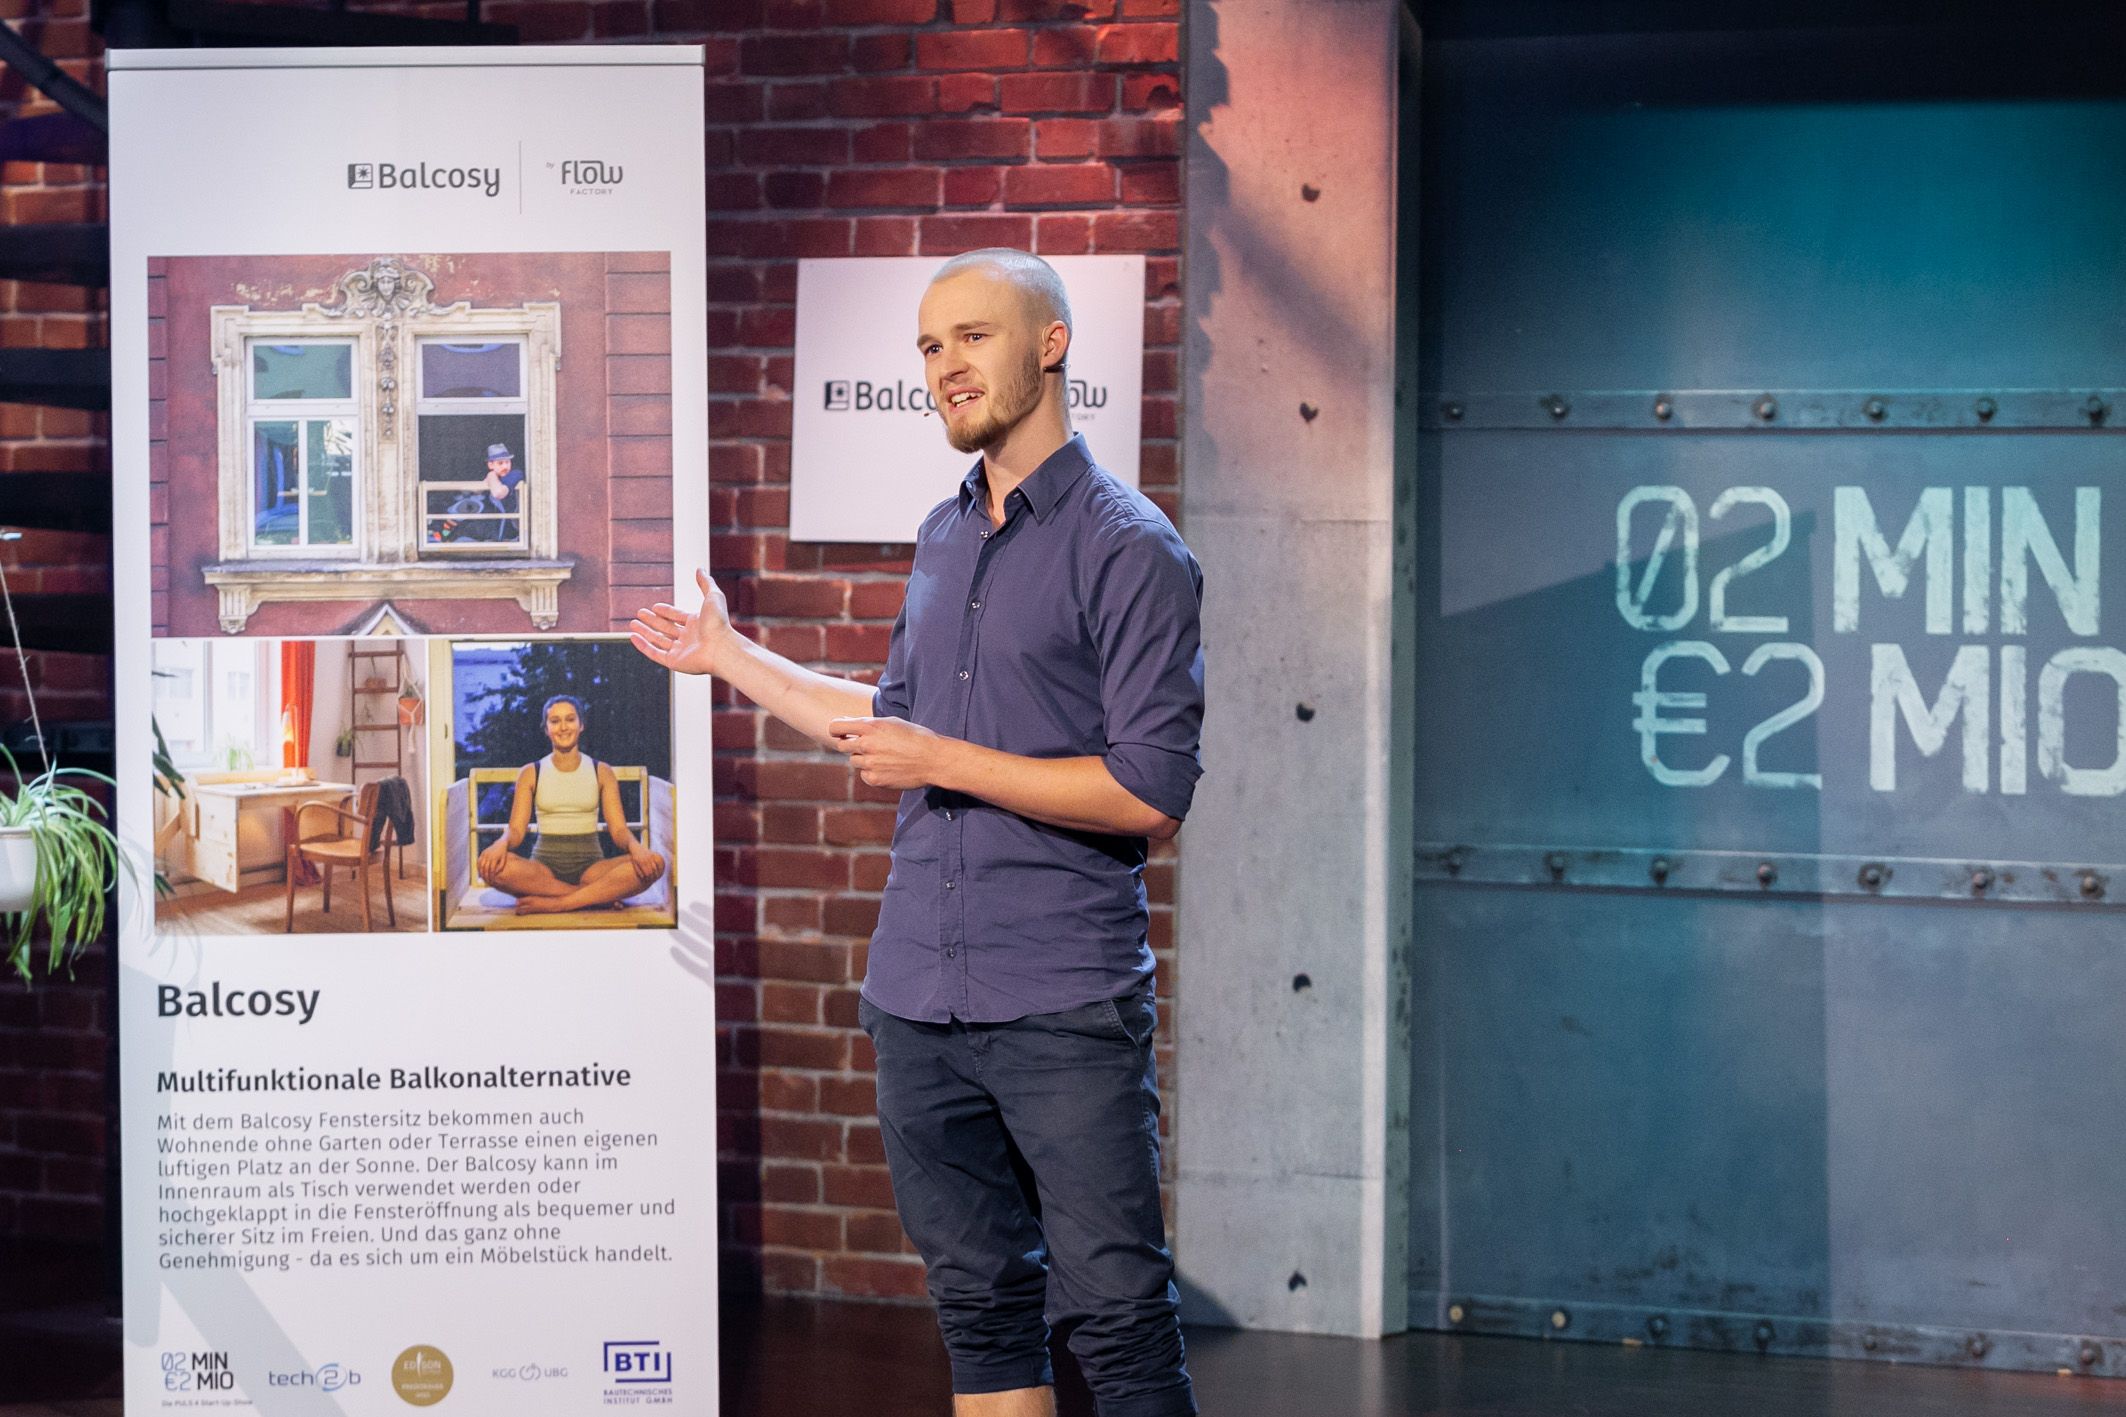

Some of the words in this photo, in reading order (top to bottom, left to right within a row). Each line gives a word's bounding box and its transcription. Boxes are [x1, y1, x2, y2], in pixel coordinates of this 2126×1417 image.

[378, 161, 501, 198] Balcosy
[569, 187, 614, 196] FACTORY
[855, 379, 938, 412] Balco
[1615, 485, 1792, 633] 02
[1833, 485, 2102, 637] MIN
[1631, 640, 1826, 791] €2
[1869, 642, 2126, 797] MIO
[157, 980, 321, 1025] Balcosy
[156, 1065, 382, 1094] Multifunktionale
[389, 1061, 632, 1091] Balkonalternative
[156, 1112, 187, 1131] Mit
[192, 1112, 234, 1131] dem
[240, 1111, 313, 1133] Balcosy
[319, 1108, 422, 1129] Fenstersitz
[427, 1108, 533, 1127] bekommen
[538, 1107, 584, 1126] auch
[156, 1135, 259, 1155] Wohnende
[264, 1134, 313, 1153] ohne
[318, 1134, 382, 1153] Garten
[388, 1132, 433, 1151] oder
[437, 1132, 519, 1150] Terrasse
[524, 1129, 577, 1149] einen
[583, 1129, 658, 1153] eigenen
[158, 1158, 231, 1181] luftigen
[237, 1158, 283, 1176] Platz
[288, 1161, 312, 1176] an
[318, 1157, 351, 1175] der
[355, 1156, 420, 1175] Sonne.
[426, 1155, 460, 1174] Der
[465, 1154, 537, 1176] Balcosy
[543, 1153, 589, 1172] kann
[595, 1152, 618, 1171] im
[158, 1183, 262, 1201] Innenraum
[267, 1180, 295, 1199] als
[300, 1179, 349, 1198] Tisch
[354, 1178, 456, 1198] verwendet
[460, 1176, 531, 1196] werden
[537, 1175, 582, 1195] oder
[158, 1204, 289, 1227] hochgeklappt
[294, 1202, 312, 1222] in
[317, 1202, 348, 1221] die
[353, 1200, 499, 1223] Fensteröffnung
[503, 1199, 531, 1218] als
[536, 1199, 634, 1222] bequemer
[639, 1197, 676, 1216] und
[158, 1227, 236, 1247] sicherer
[241, 1226, 276, 1246] Sitz
[281, 1225, 304, 1245] im
[311, 1224, 375, 1245] Freien.
[380, 1224, 418, 1243] Und
[424, 1224, 459, 1243] das
[463, 1226, 508, 1246] ganz
[513, 1222, 561, 1241] ohne
[158, 1249, 291, 1273] Genehmigung
[309, 1249, 333, 1268] da
[339, 1252, 361, 1267] es
[365, 1247, 403, 1267] sich
[409, 1251, 439, 1266] um
[444, 1245, 474, 1265] ein
[480, 1244, 589, 1265] Möbelstück
[595, 1243, 673, 1263] handelt.
[161, 1351, 187, 1372] 02
[191, 1351, 228, 1371] MIN
[491, 1367, 517, 1379] KGG
[543, 1366, 568, 1378] UBG
[614, 1351, 661, 1372] BTI
[164, 1371, 192, 1391] €2
[196, 1370, 235, 1391] MIO
[602, 1387, 674, 1397] BAUTECHNISCHES
[602, 1396, 641, 1405] INSTITUT
